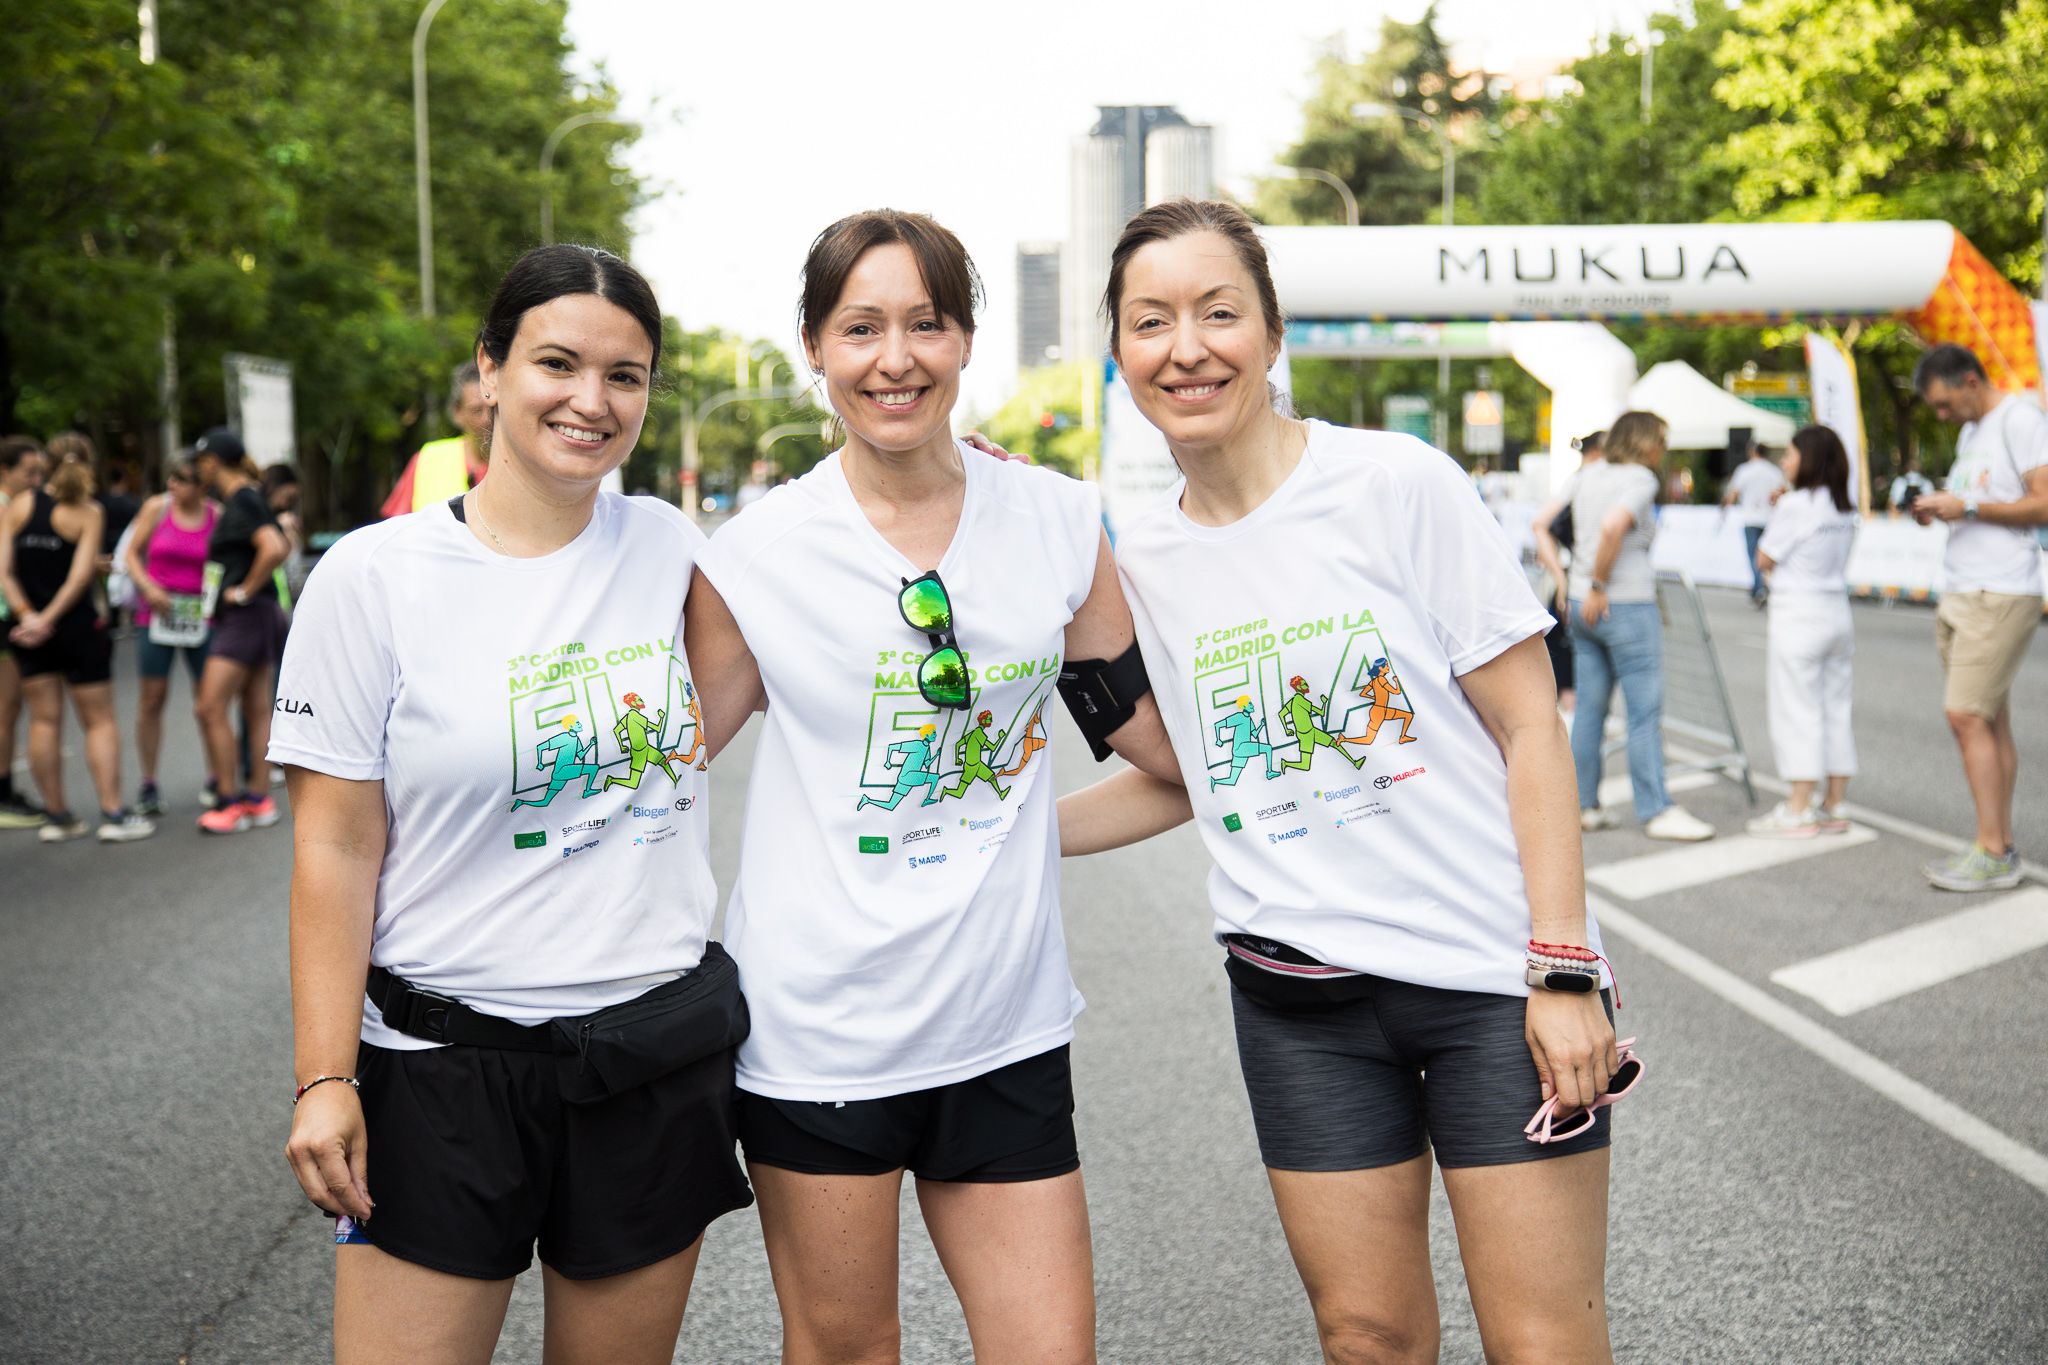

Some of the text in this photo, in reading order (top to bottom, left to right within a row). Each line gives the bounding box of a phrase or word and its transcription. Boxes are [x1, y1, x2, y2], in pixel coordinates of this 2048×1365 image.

[1437, 244, 1751, 282] MUKUA
[1193, 608, 1376, 673] MADRID CON LA
[1194, 617, 1268, 650] 3ª Carrera
[507, 640, 585, 672] 3ª Carrera
[508, 635, 676, 694] MADRID CON L
[876, 650, 897, 666] 3ª
[874, 653, 1059, 689] MAD CON LA
[1324, 784, 1361, 802] Biogen
[633, 806, 670, 819] Biogen
[562, 821, 588, 836] SPORT
[588, 818, 607, 828] LIFE
[925, 826, 941, 836] LIFE
[969, 815, 1003, 831] Biogen
[1277, 827, 1308, 842] MADRID
[571, 839, 600, 855] MADRID
[918, 854, 947, 865] MADRID
